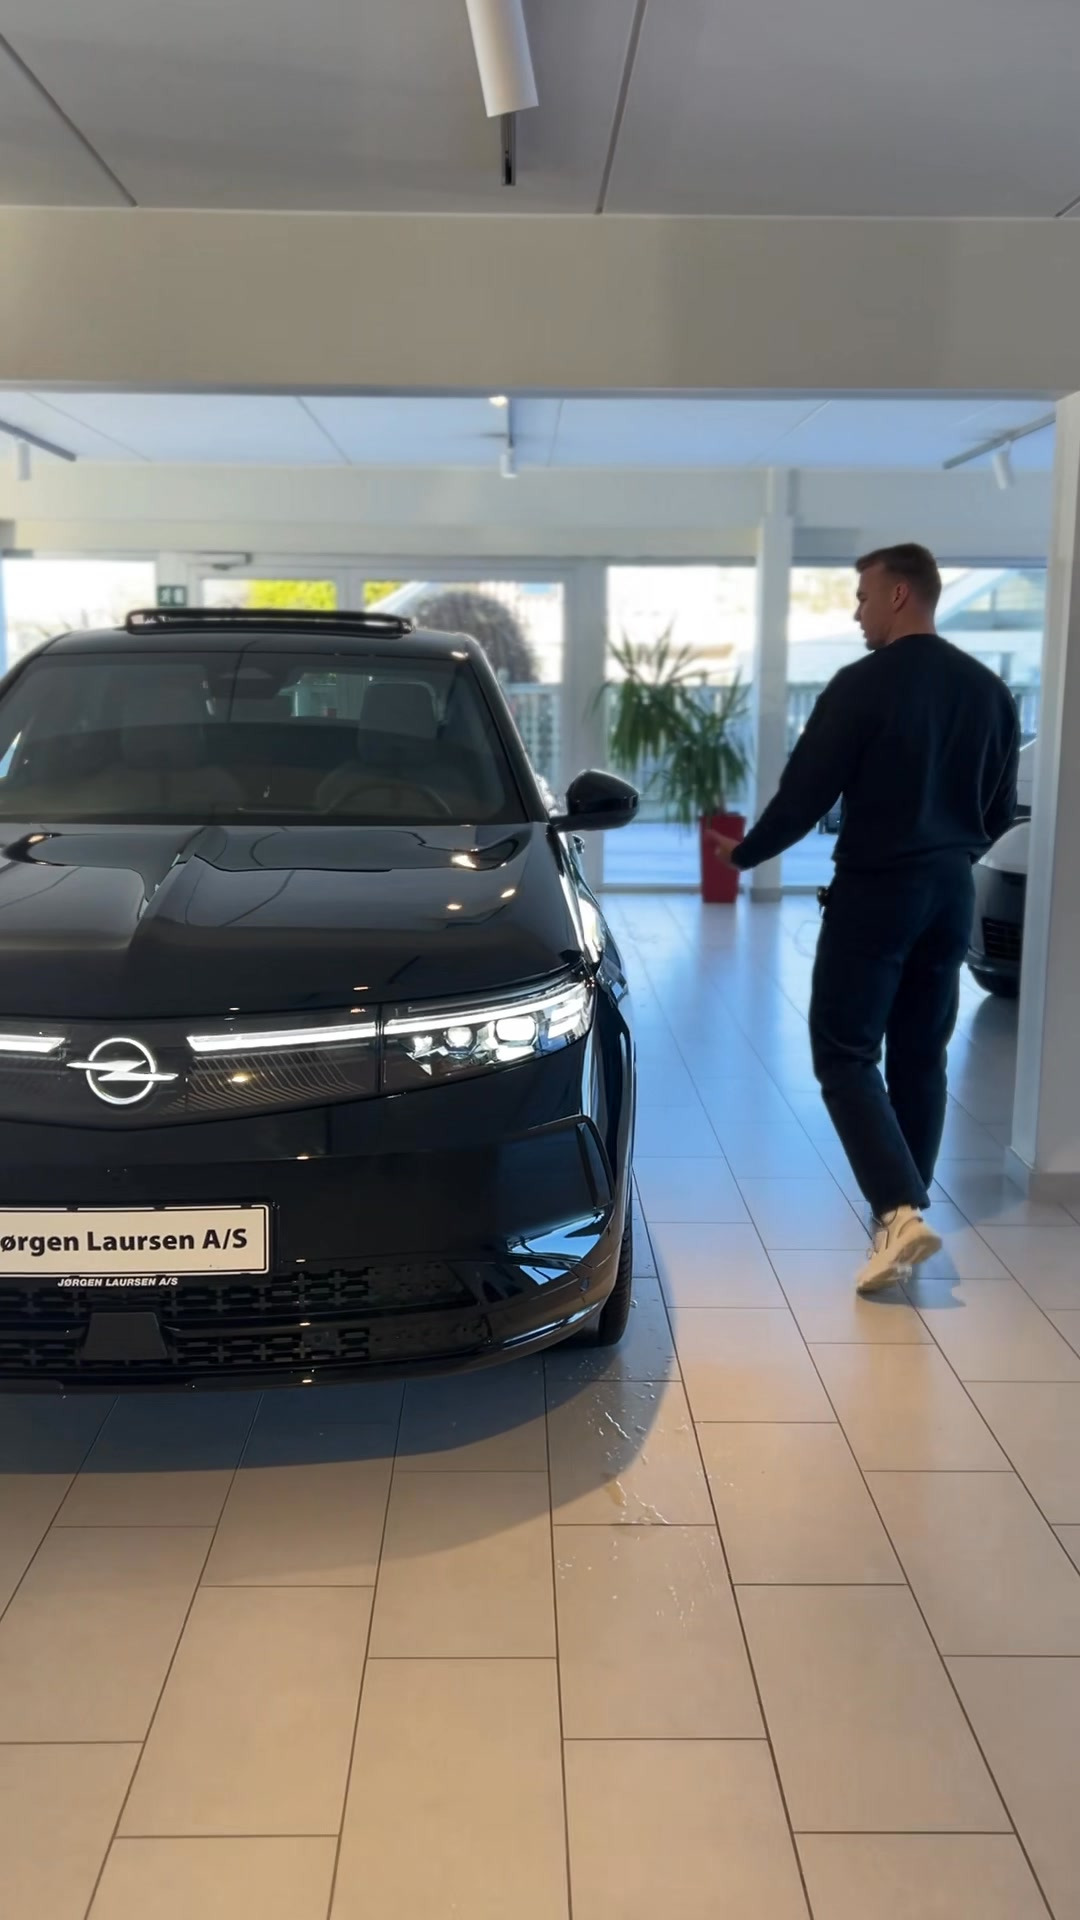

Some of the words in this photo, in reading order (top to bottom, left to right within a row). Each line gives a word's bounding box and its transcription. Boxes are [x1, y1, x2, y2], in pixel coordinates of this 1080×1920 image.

[0, 1235, 79, 1257] ørgen
[87, 1231, 195, 1251] Laursen
[202, 1228, 248, 1250] A/S
[57, 1278, 102, 1287] JØRGEN
[105, 1277, 156, 1287] LAURSEN
[159, 1277, 178, 1286] A/S
